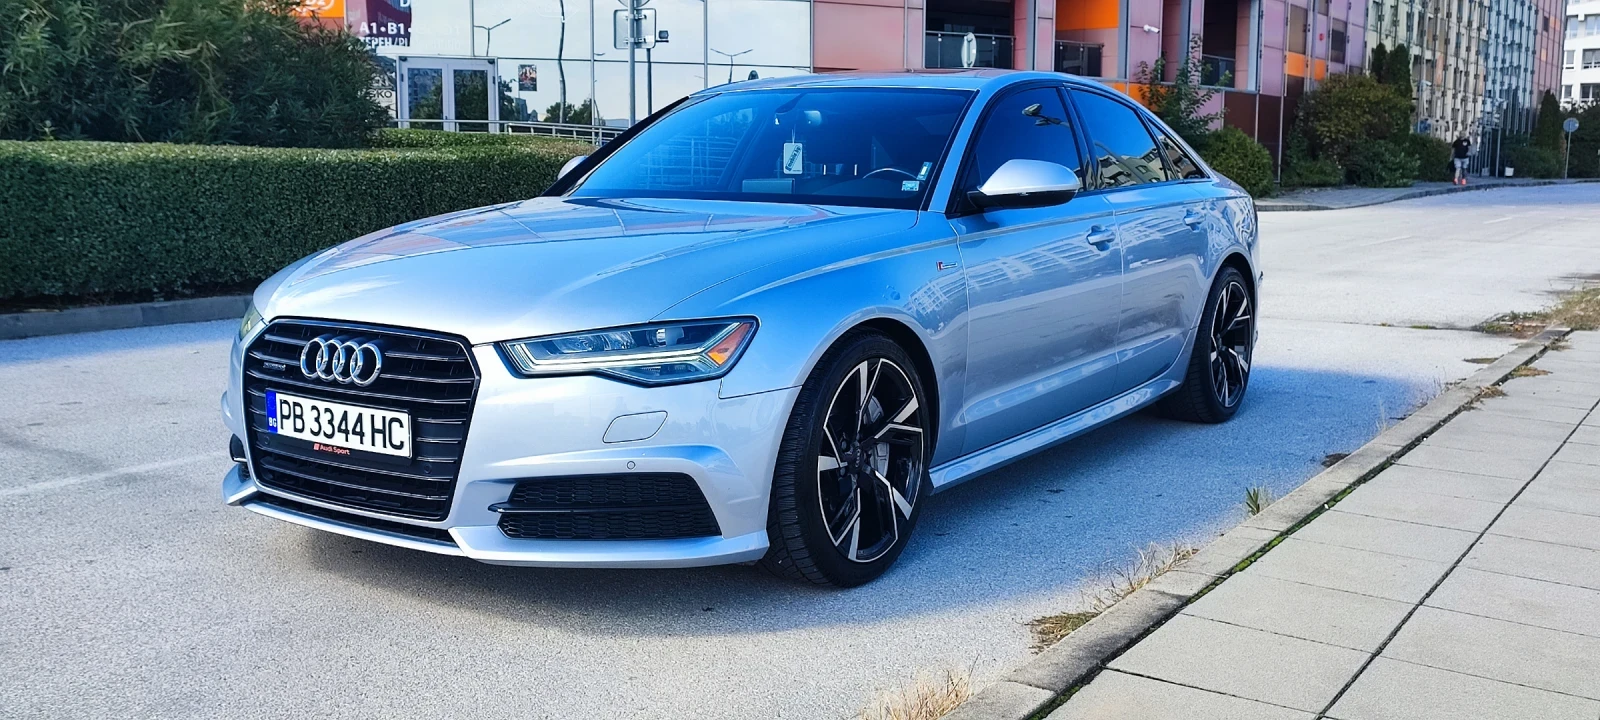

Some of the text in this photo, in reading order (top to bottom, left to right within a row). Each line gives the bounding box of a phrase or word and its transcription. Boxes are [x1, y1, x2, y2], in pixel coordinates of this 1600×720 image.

[268, 399, 404, 450] BG PB 3344 HC
[320, 444, 350, 455] Audi Sport
